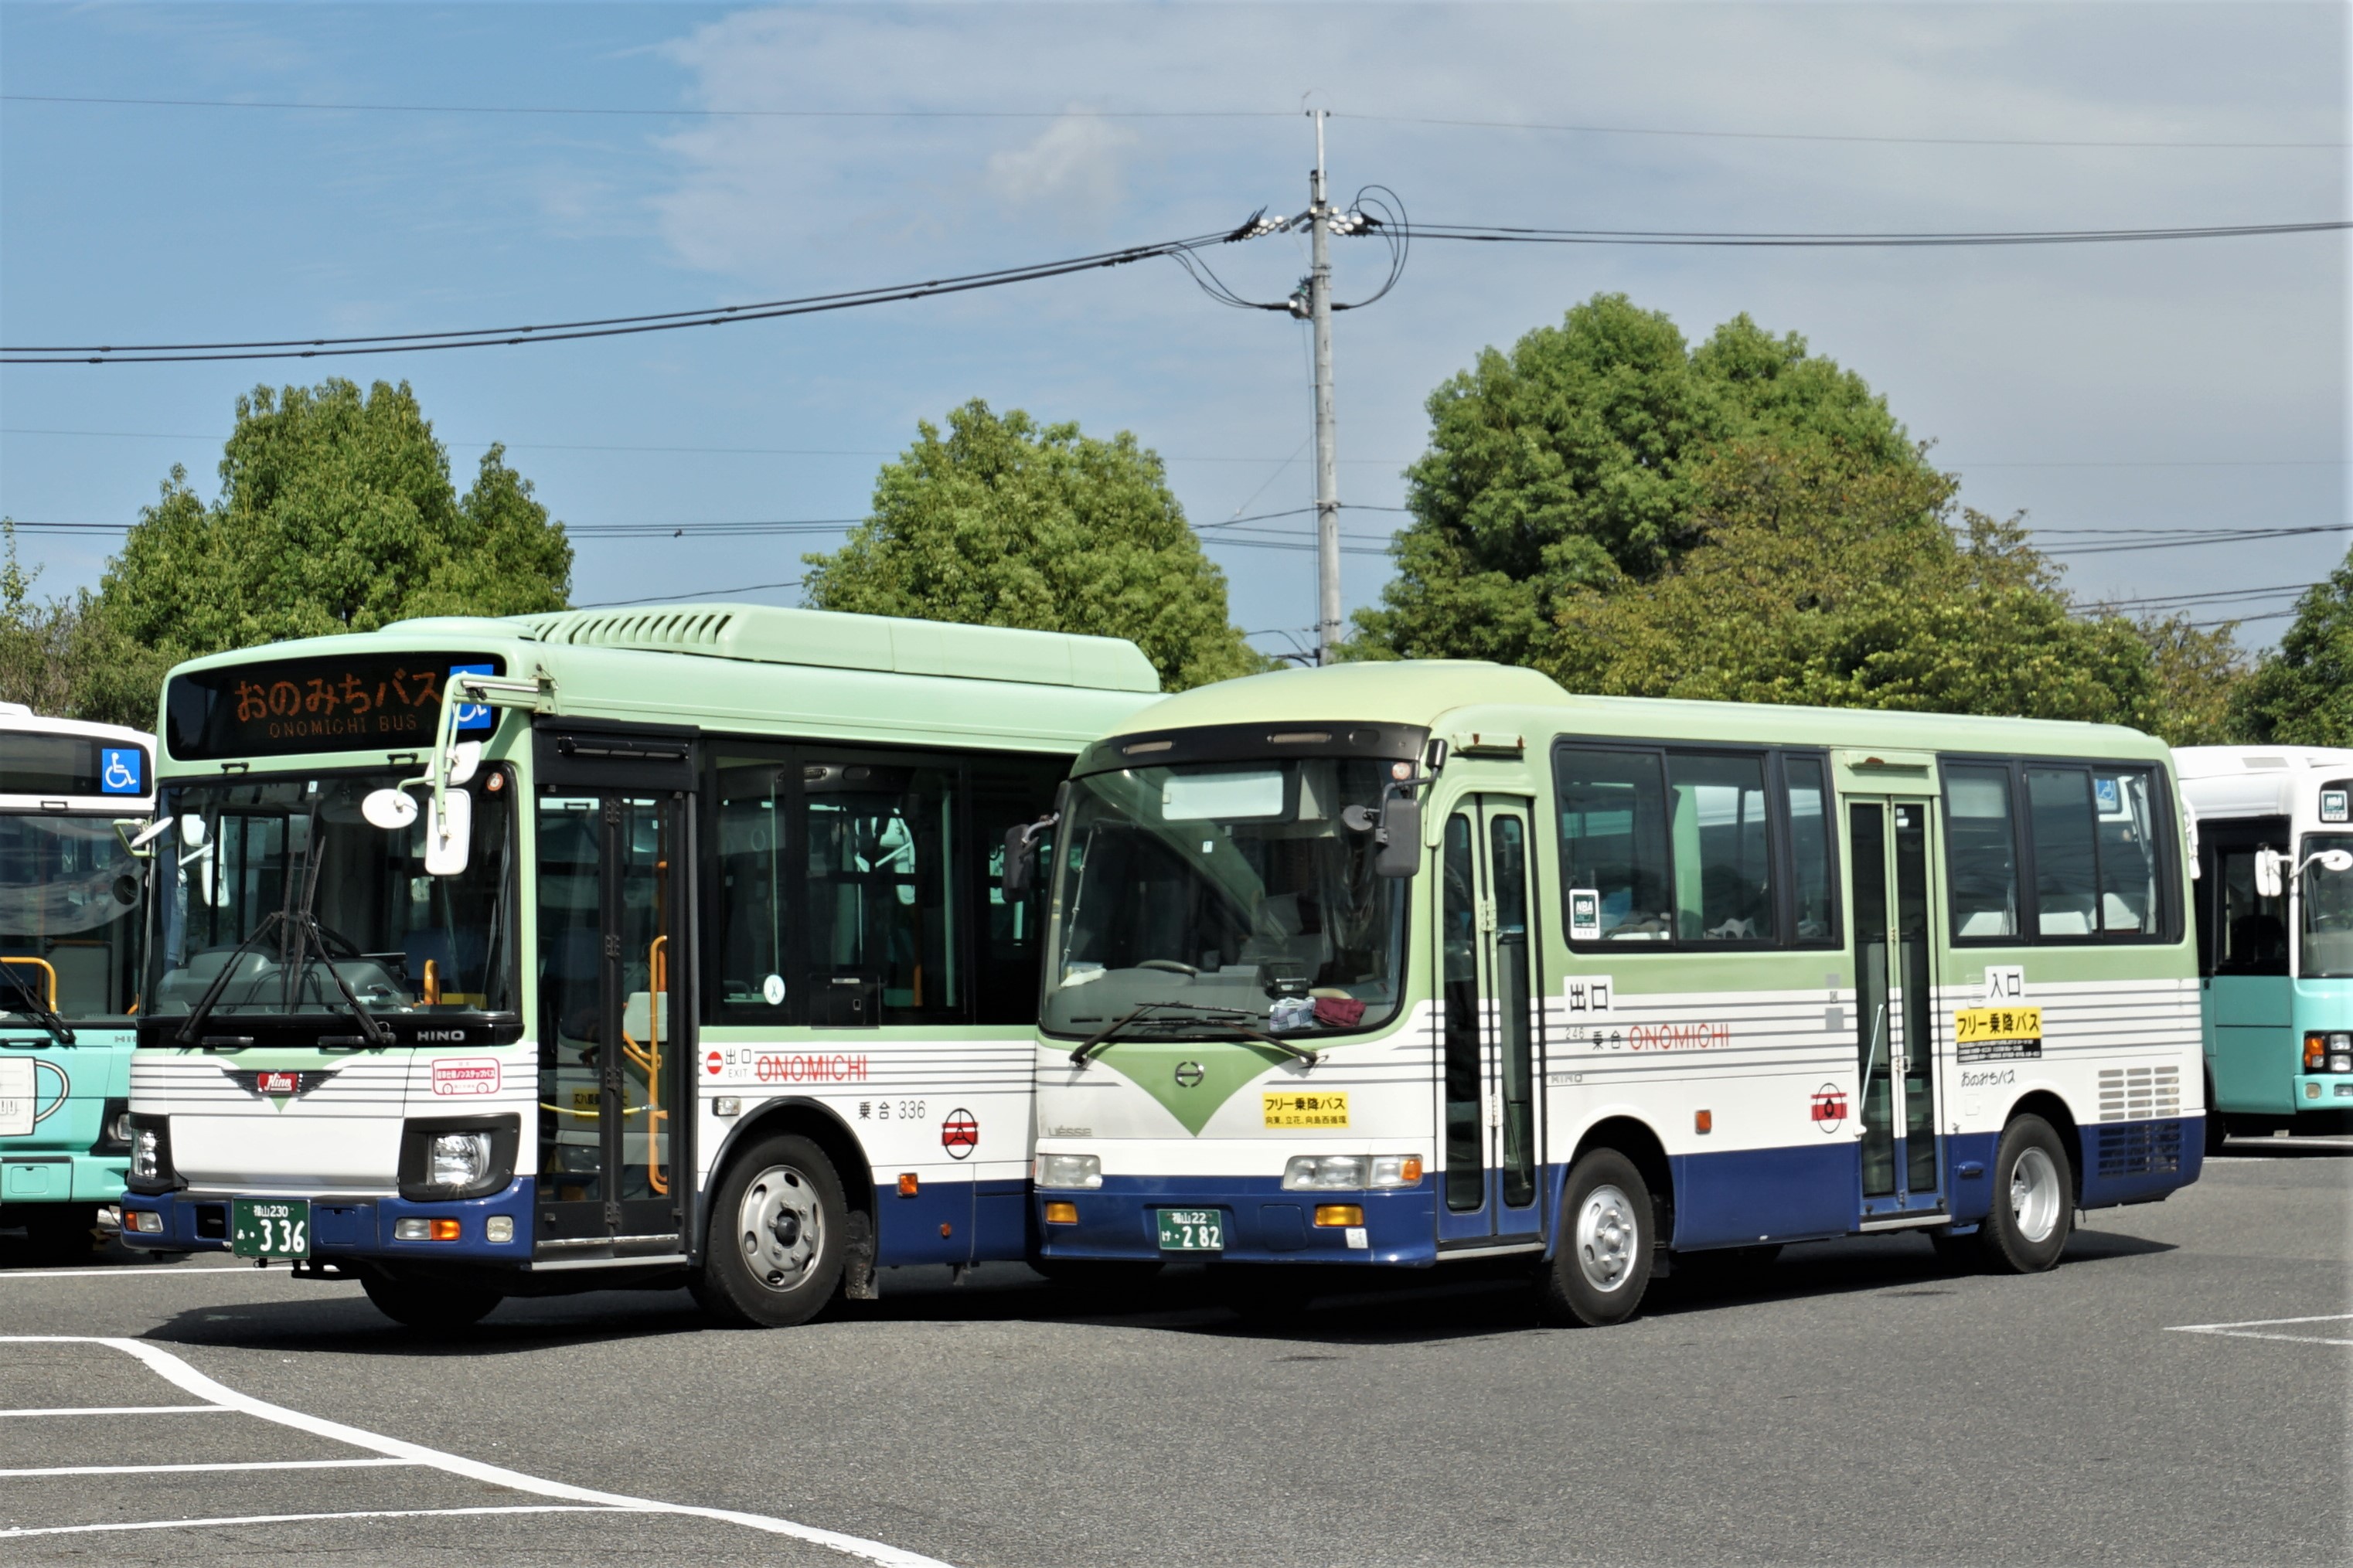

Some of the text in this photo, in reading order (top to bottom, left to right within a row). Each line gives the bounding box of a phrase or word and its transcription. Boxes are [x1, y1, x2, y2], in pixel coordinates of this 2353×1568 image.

[234, 668, 442, 721] おのみちバス
[270, 714, 417, 738] ONOMICHI BUS
[1570, 983, 1608, 1012] 出口
[1990, 973, 2021, 998] 入口
[417, 1030, 465, 1041] HINO
[1565, 1027, 1585, 1039] 246
[1629, 1023, 1729, 1049] ONOMICHI
[1957, 1012, 2040, 1036] フリー乗降バス
[726, 1048, 751, 1064] 出口
[728, 1068, 747, 1078] EXIT
[758, 1055, 867, 1082] ONOMICHI
[859, 1100, 926, 1120] 乗合 336
[1265, 1097, 1346, 1111] フリー乗降バス
